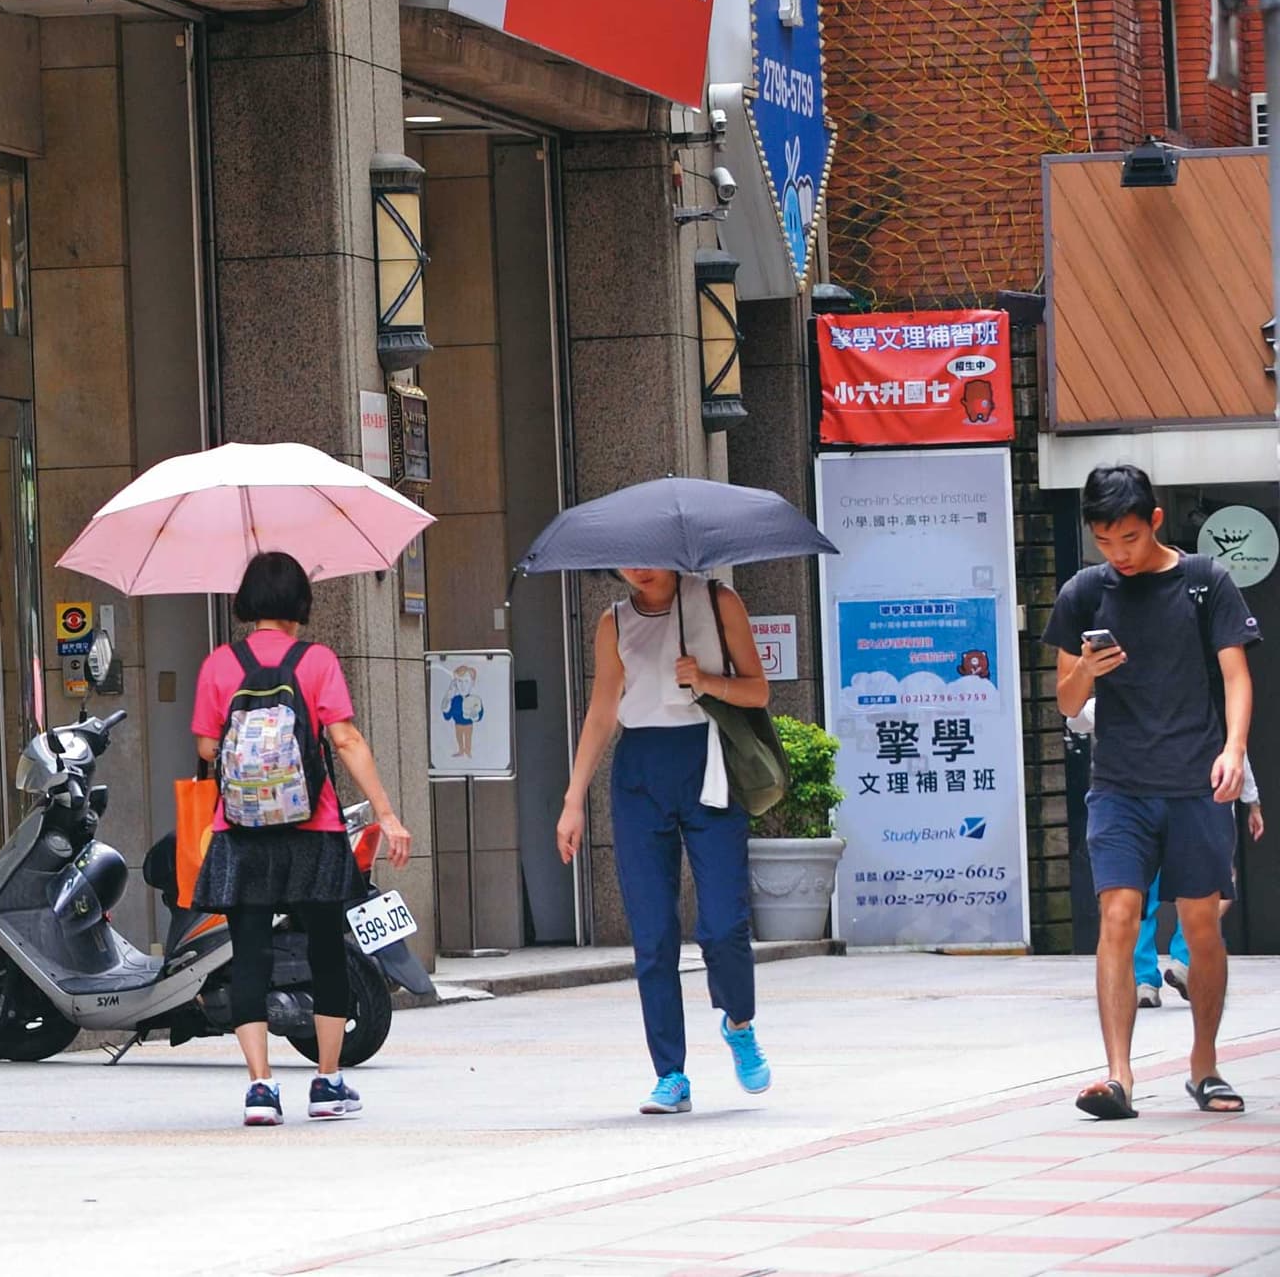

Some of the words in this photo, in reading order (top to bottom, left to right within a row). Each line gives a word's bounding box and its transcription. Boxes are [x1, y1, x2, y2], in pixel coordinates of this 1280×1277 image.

[761, 57, 814, 119] 2796-5759
[830, 320, 999, 351] 擎學文理補習班
[833, 379, 951, 407] 小六升國七
[892, 492, 938, 507] Science
[940, 491, 988, 505] Institute
[875, 717, 975, 765] 擎學
[857, 768, 996, 795] 文理補習班
[882, 826, 956, 844] StudyBank
[883, 865, 1007, 883] 02-2792-6615
[884, 888, 1007, 908] 02-2796-5759
[354, 906, 412, 948] 599-JZR
[95, 993, 121, 1007] SYM
